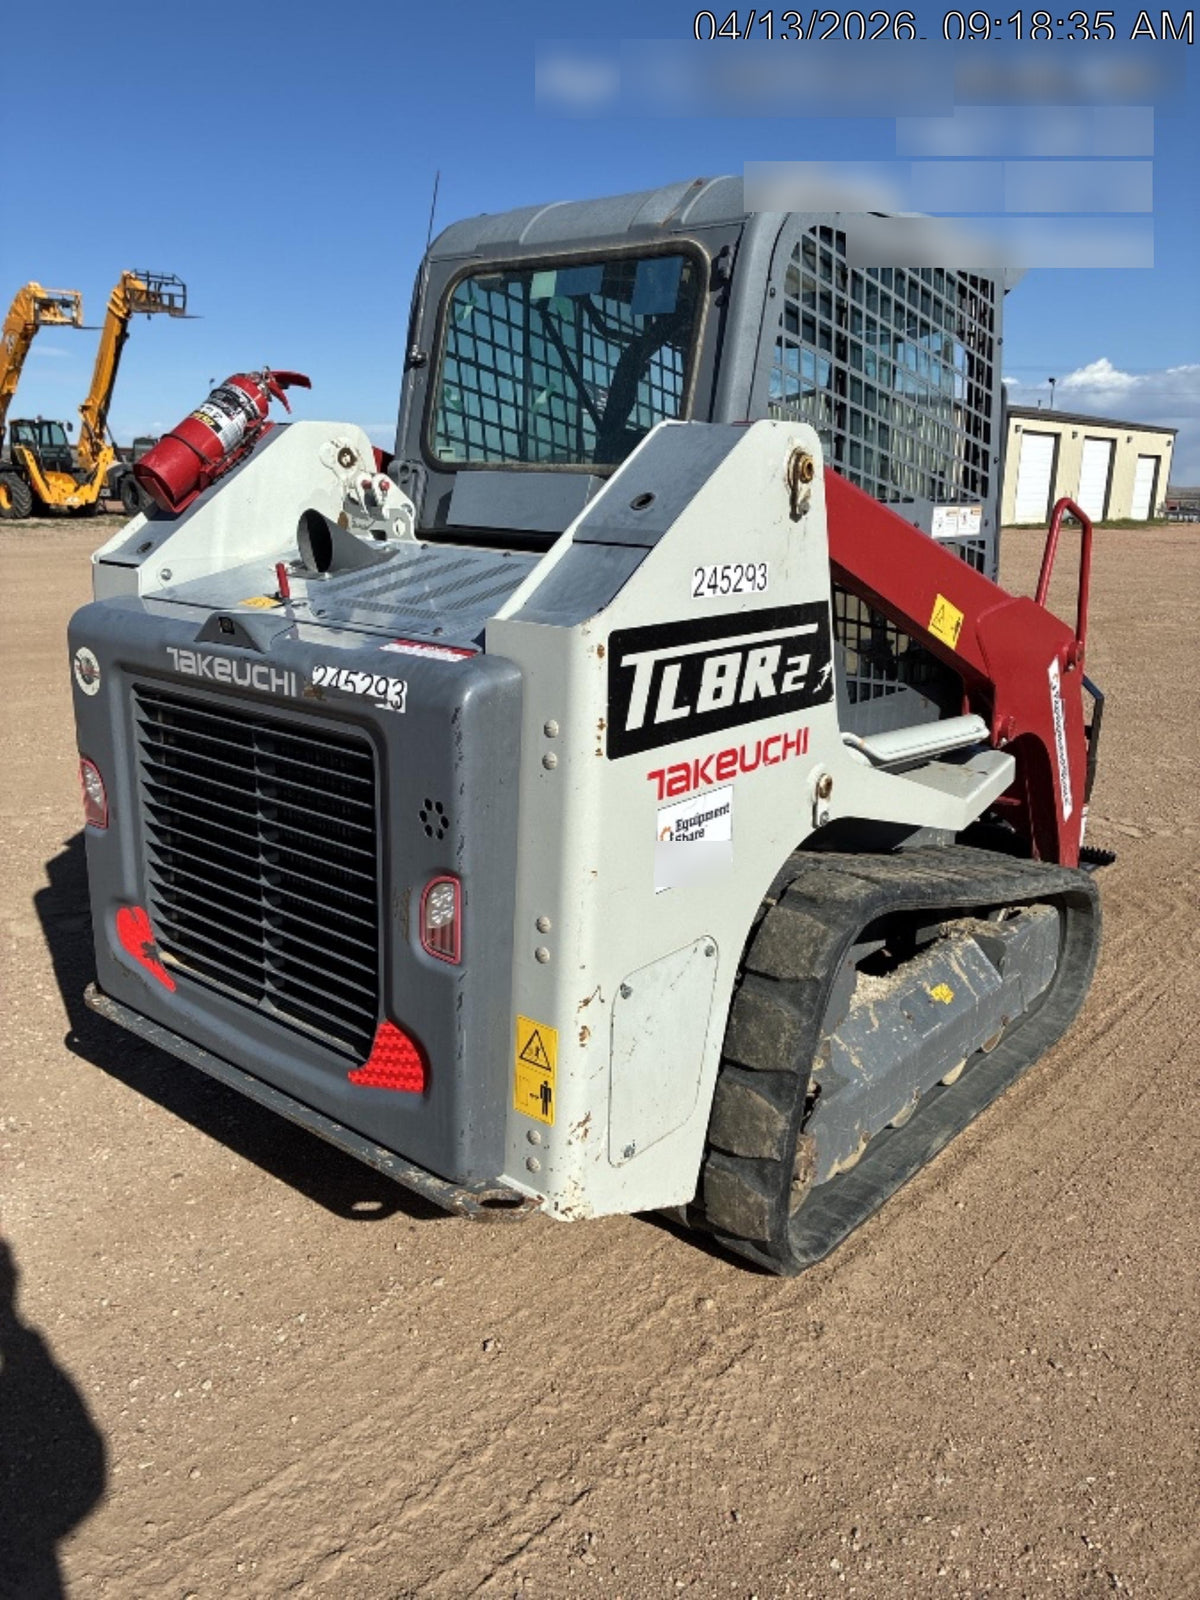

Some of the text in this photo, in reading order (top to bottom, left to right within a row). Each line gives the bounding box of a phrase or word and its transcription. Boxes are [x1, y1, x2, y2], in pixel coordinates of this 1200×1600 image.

[692, 563, 768, 597] 245293
[312, 664, 405, 710] 245293
[675, 802, 731, 832] Equipment
